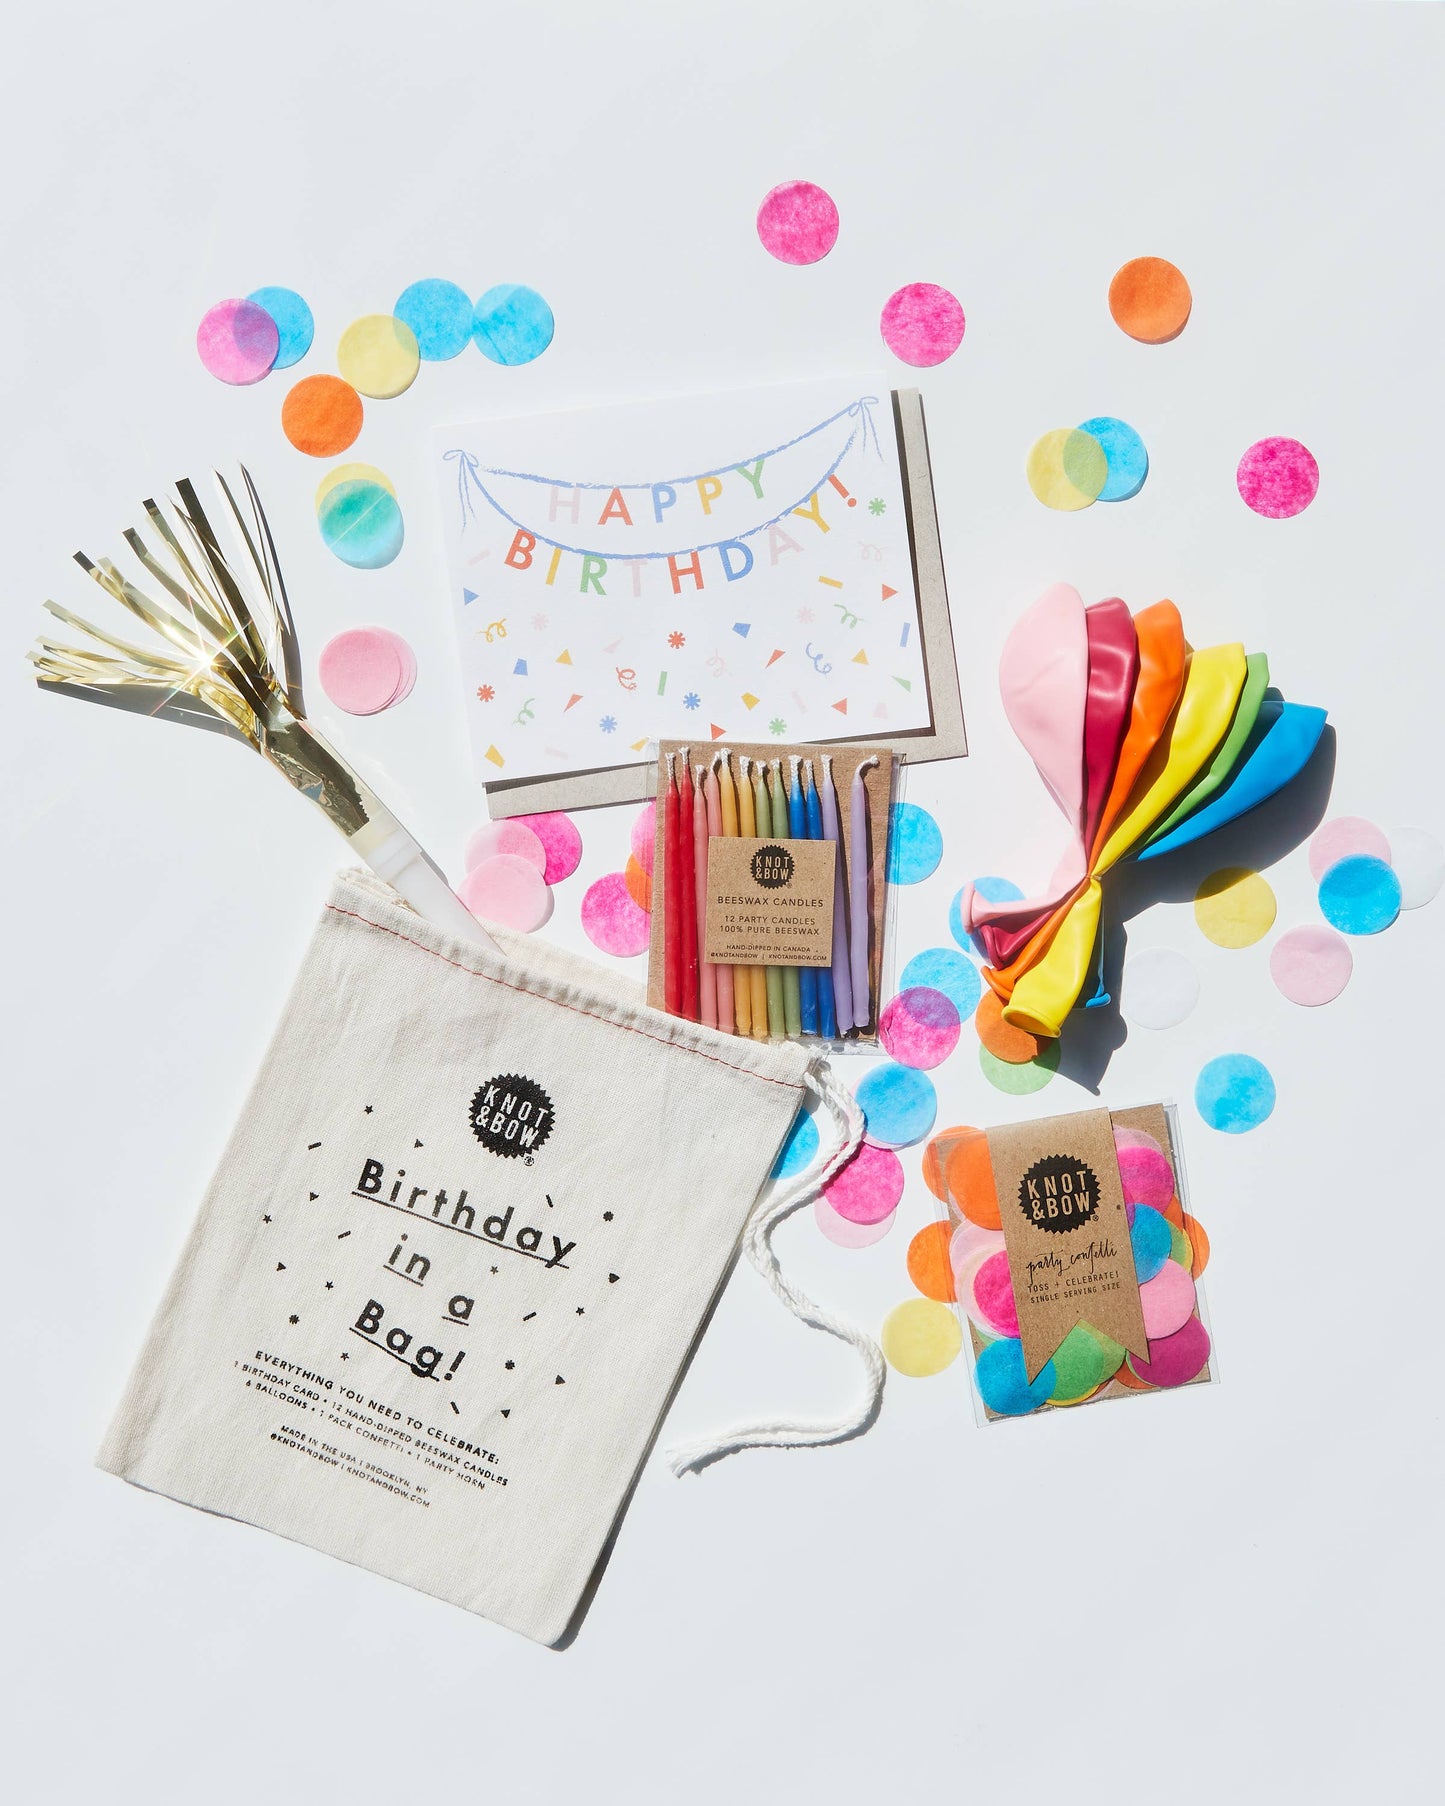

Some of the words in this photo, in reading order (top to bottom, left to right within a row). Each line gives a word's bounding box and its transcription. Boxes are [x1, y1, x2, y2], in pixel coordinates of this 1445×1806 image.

[548, 458, 765, 526] HAPPY
[504, 474, 857, 597] BIRTHDAY!
[755, 855, 790, 868] KNOT
[755, 868, 790, 880] &BOW
[717, 896, 769, 905] BEESWAX
[773, 898, 824, 907] CANDLES
[772, 917, 816, 925] CANDLES
[720, 925, 743, 933] 100%
[775, 927, 820, 936] BEESWAX
[475, 1105, 539, 1148] &BOW
[484, 1084, 549, 1128] KNOT
[1027, 1170, 1086, 1200] KNOT
[1031, 1192, 1090, 1220] &BOW
[357, 1158, 577, 1269] Birthday
[388, 1233, 431, 1281] in
[1026, 1249, 1070, 1285] party
[1070, 1239, 1118, 1274] confetti
[1028, 1283, 1050, 1294] TOSS
[1066, 1270, 1120, 1287] CELEBRATE!
[1030, 1293, 1060, 1304] SINGLE
[1064, 1286, 1097, 1298] SERVING
[1102, 1282, 1120, 1292] SIZE
[448, 1294, 475, 1320] a
[355, 1299, 466, 1382] Bag!
[242, 1364, 291, 1388] BIRTHDAY
[293, 1384, 320, 1401] CARD
[332, 1402, 342, 1412] 12
[345, 1408, 412, 1442] HAND-DIPPED
[414, 1440, 460, 1464] BEESWAX
[464, 1462, 508, 1486] CANDLES
[255, 1350, 334, 1390] EVERYTHING
[340, 1385, 364, 1404] YOU
[368, 1400, 402, 1420] NEED
[406, 1417, 422, 1430] TO
[427, 1427, 500, 1464] CELEBRATE:
[255, 1382, 308, 1410] BALLOONS
[328, 1414, 352, 1430] PACK
[356, 1426, 404, 1452] CONFETTI
[424, 1458, 455, 1474] PARTY
[456, 1472, 486, 1490] HORN
[280, 1425, 306, 1441] MADE
[308, 1436, 318, 1446] IN
[322, 1444, 338, 1455] THE
[340, 1451, 356, 1464] USA
[416, 1485, 428, 1494] NY
[346, 1466, 430, 1508] KNOTANDBOW.COM
